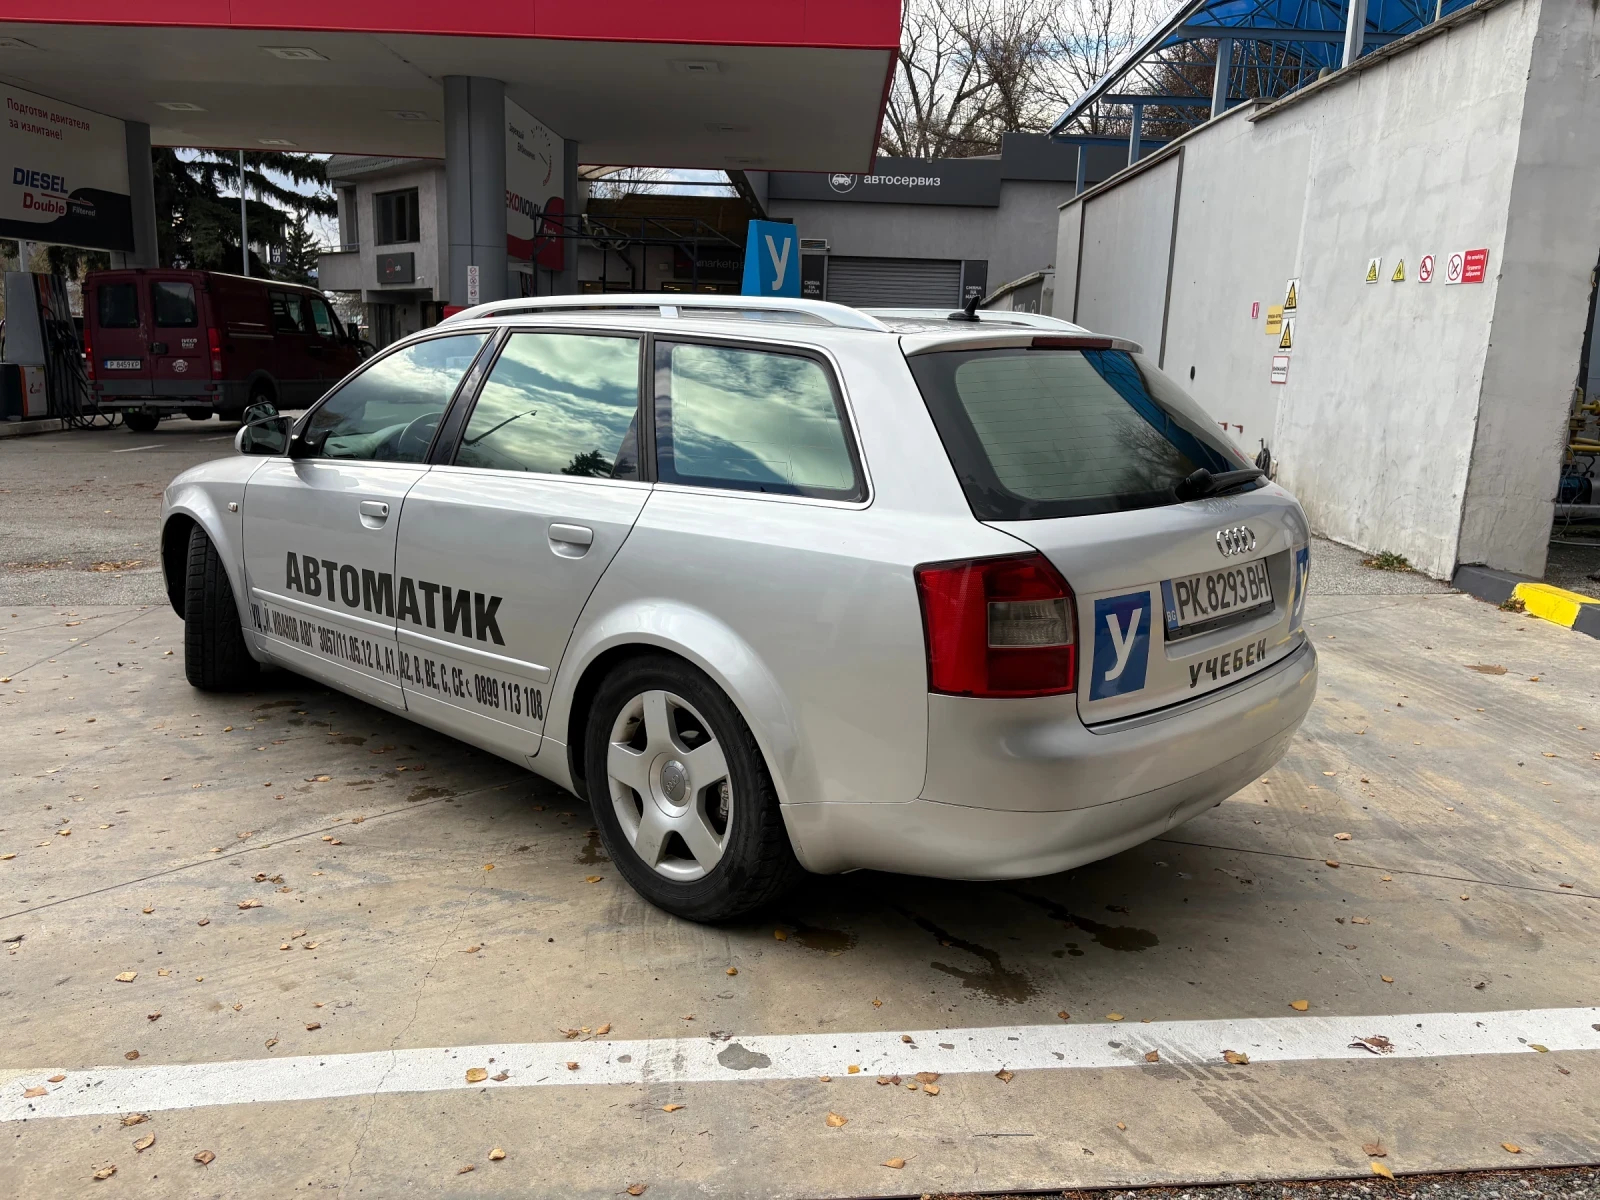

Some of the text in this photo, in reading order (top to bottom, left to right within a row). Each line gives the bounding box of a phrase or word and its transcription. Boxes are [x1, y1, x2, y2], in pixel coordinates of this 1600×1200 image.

[7, 97, 90, 132] Подготви двигателя
[9, 118, 63, 141] за излитане!
[13, 167, 68, 194] DIESEL
[863, 174, 941, 188] автосервиз
[22, 191, 66, 215] Double
[72, 205, 96, 217] Filtered
[764, 234, 792, 291] У
[286, 551, 506, 647] АВТОМАТИК
[1206, 569, 1248, 612] 8293
[1166, 610, 1177, 622] BG
[1105, 607, 1143, 682] У
[1188, 637, 1267, 689] УЧЕБЕН
[475, 673, 500, 708] 0899
[501, 681, 521, 715] 113
[524, 686, 543, 721] 108
